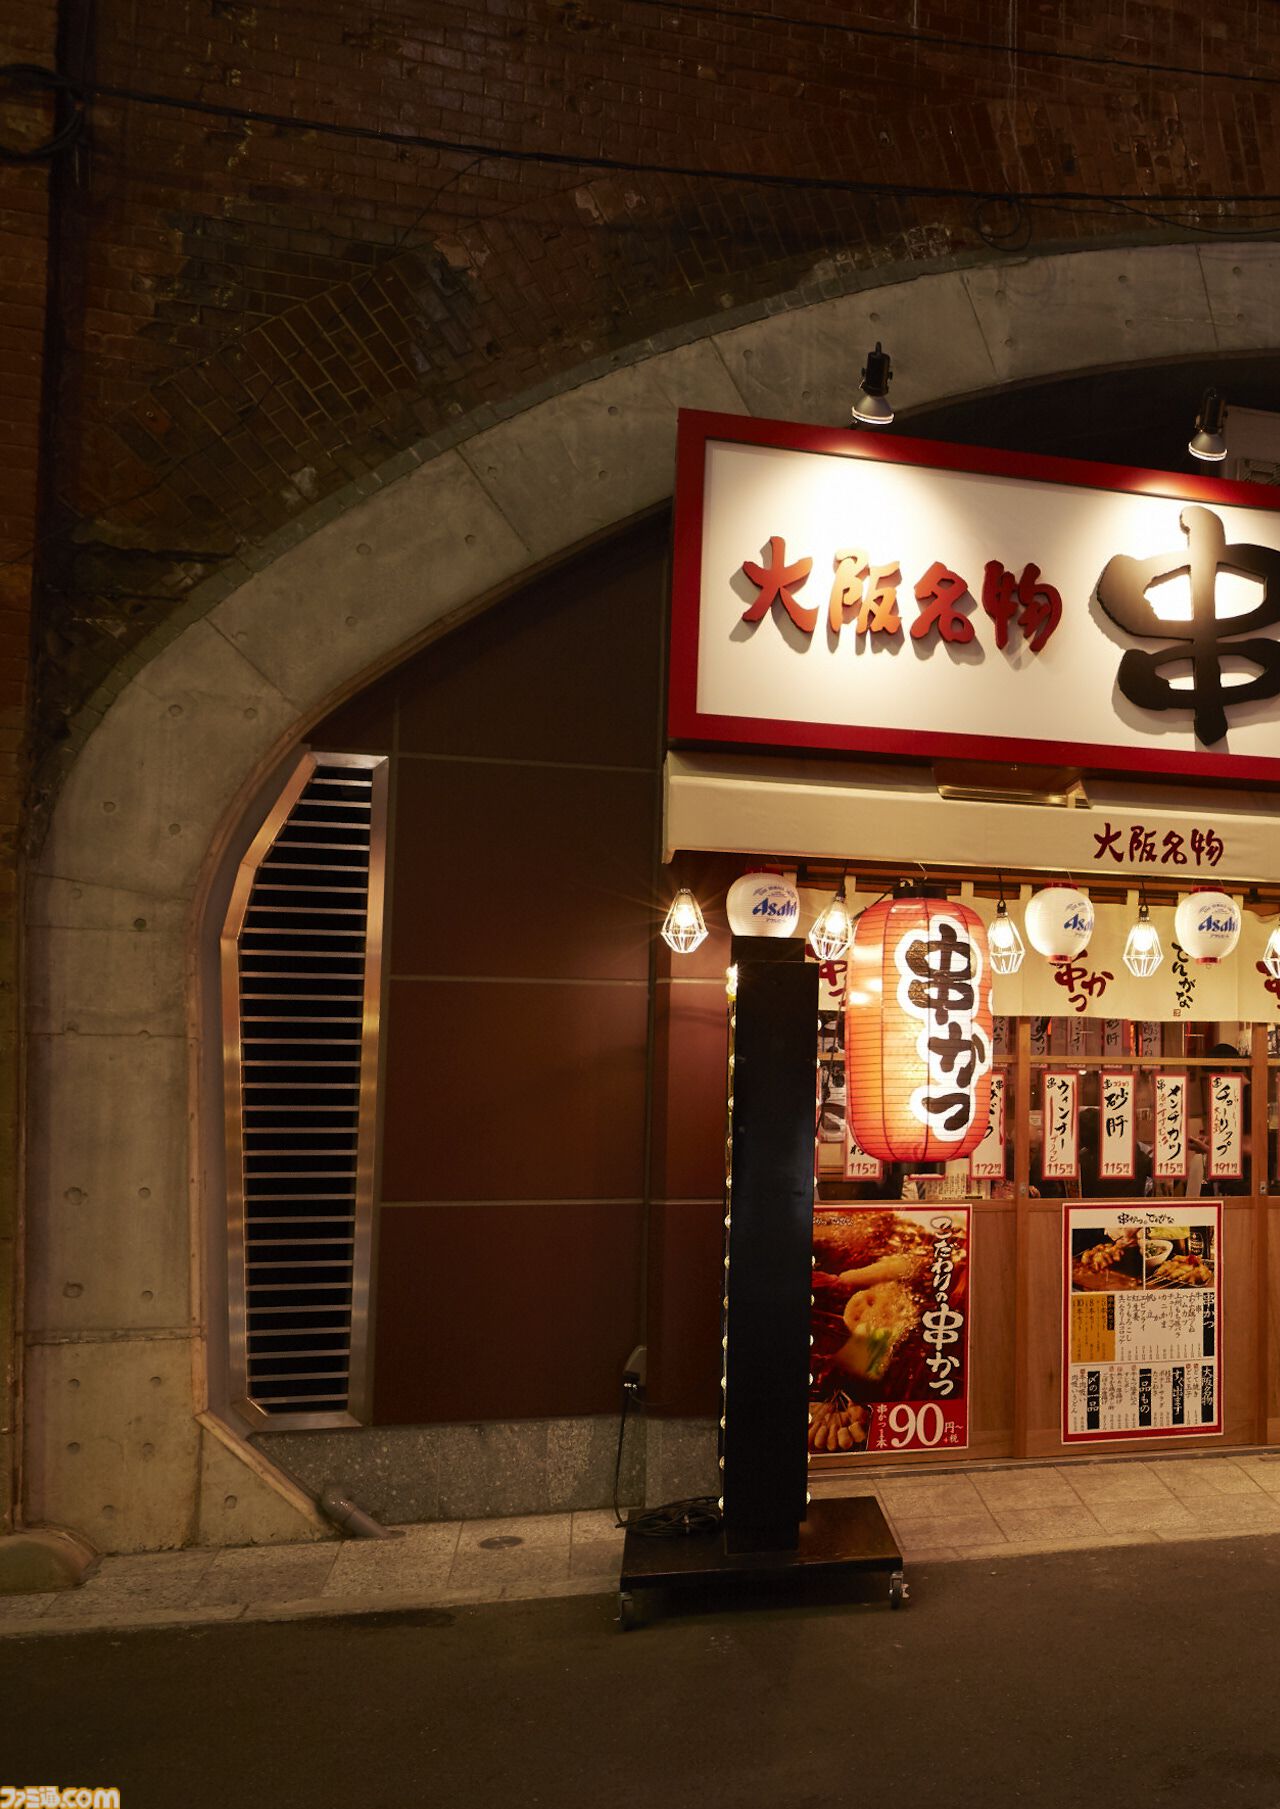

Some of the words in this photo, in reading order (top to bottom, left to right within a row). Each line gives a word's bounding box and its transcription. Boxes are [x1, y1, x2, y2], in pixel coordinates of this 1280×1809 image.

[742, 535, 1063, 653] 大阪名物
[1093, 822, 1225, 867] 大阪名物
[752, 897, 797, 917] Asahi
[905, 923, 986, 1132] 串かつ
[1054, 1080, 1070, 1150] ウィンナー
[1104, 1087, 1129, 1138] 砂肝
[1167, 1085, 1182, 1161] メンチカツ
[922, 1216, 964, 1396] こだわりの串かつ
[1087, 1373, 1099, 1413] 〆の一品
[1139, 1373, 1151, 1414] 一品もの
[1172, 1369, 1183, 1416] すぐ出ます
[1202, 1367, 1213, 1407] 大阪名物
